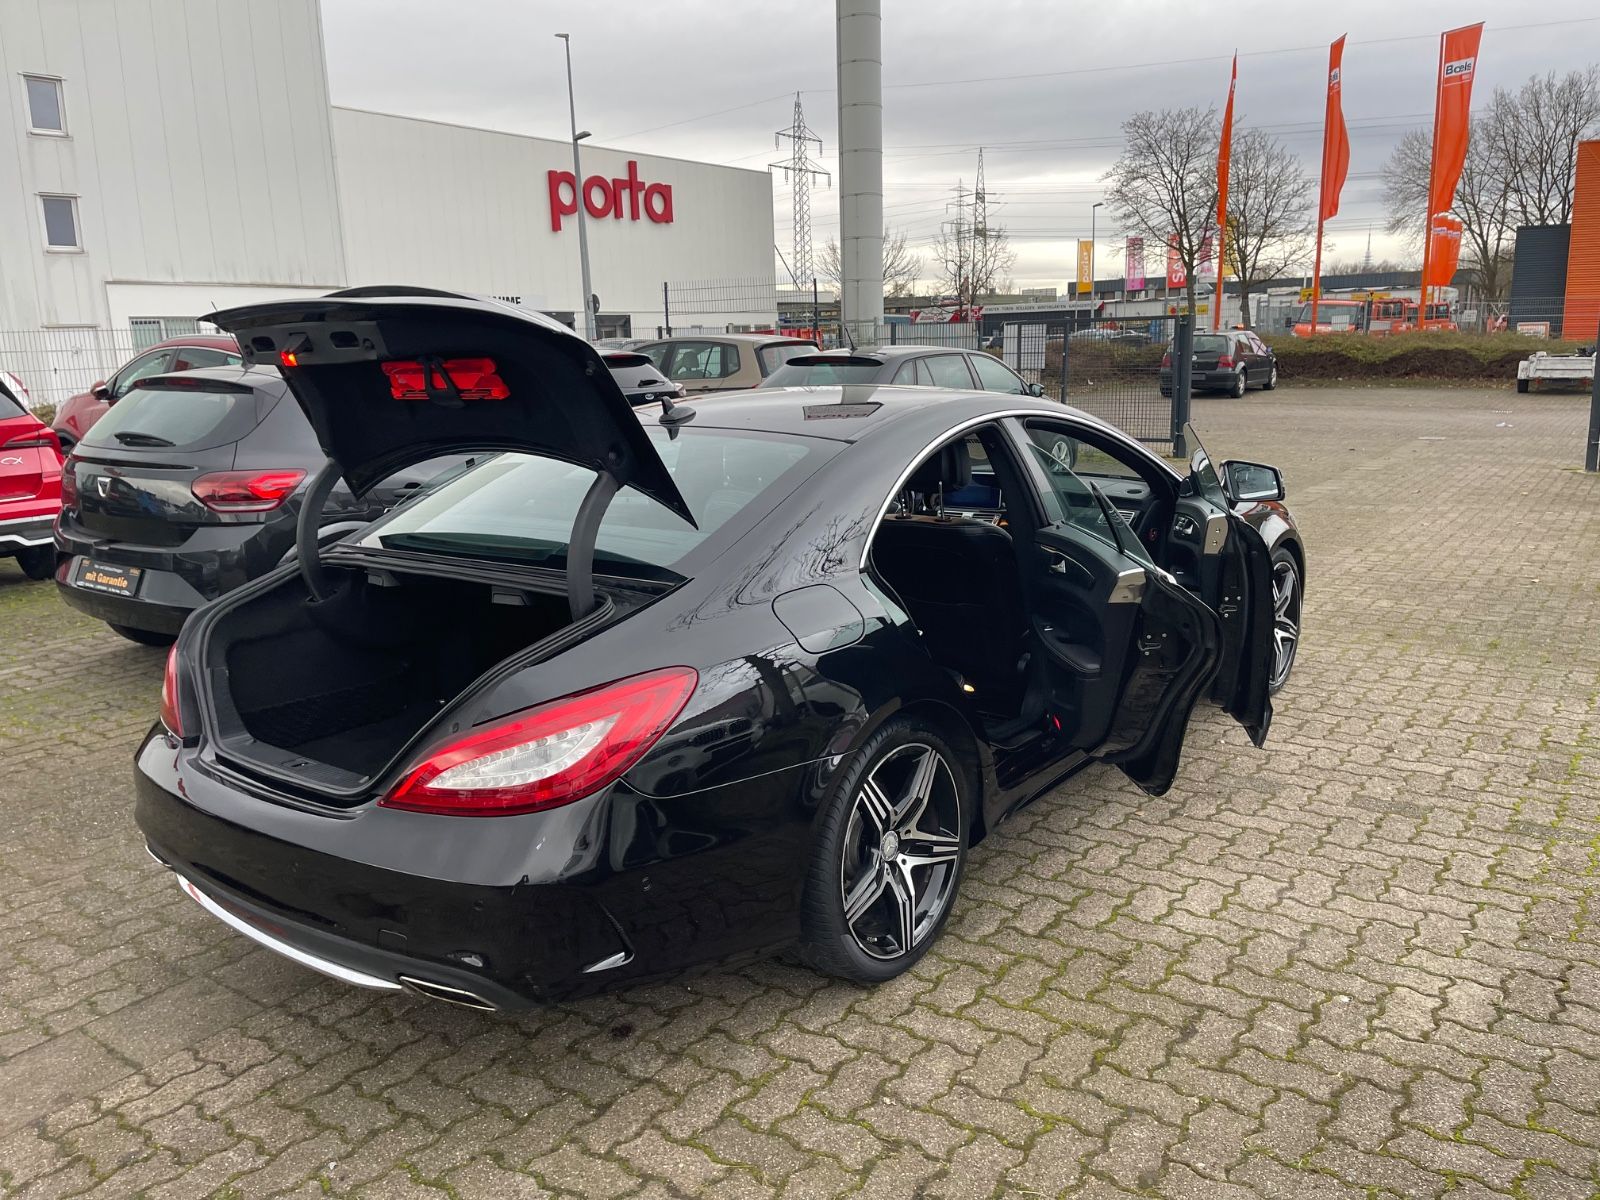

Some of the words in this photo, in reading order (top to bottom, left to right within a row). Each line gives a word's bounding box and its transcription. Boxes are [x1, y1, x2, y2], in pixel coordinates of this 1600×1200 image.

[548, 160, 673, 232] porta
[85, 571, 97, 582] mit
[97, 573, 128, 588] Garantie
